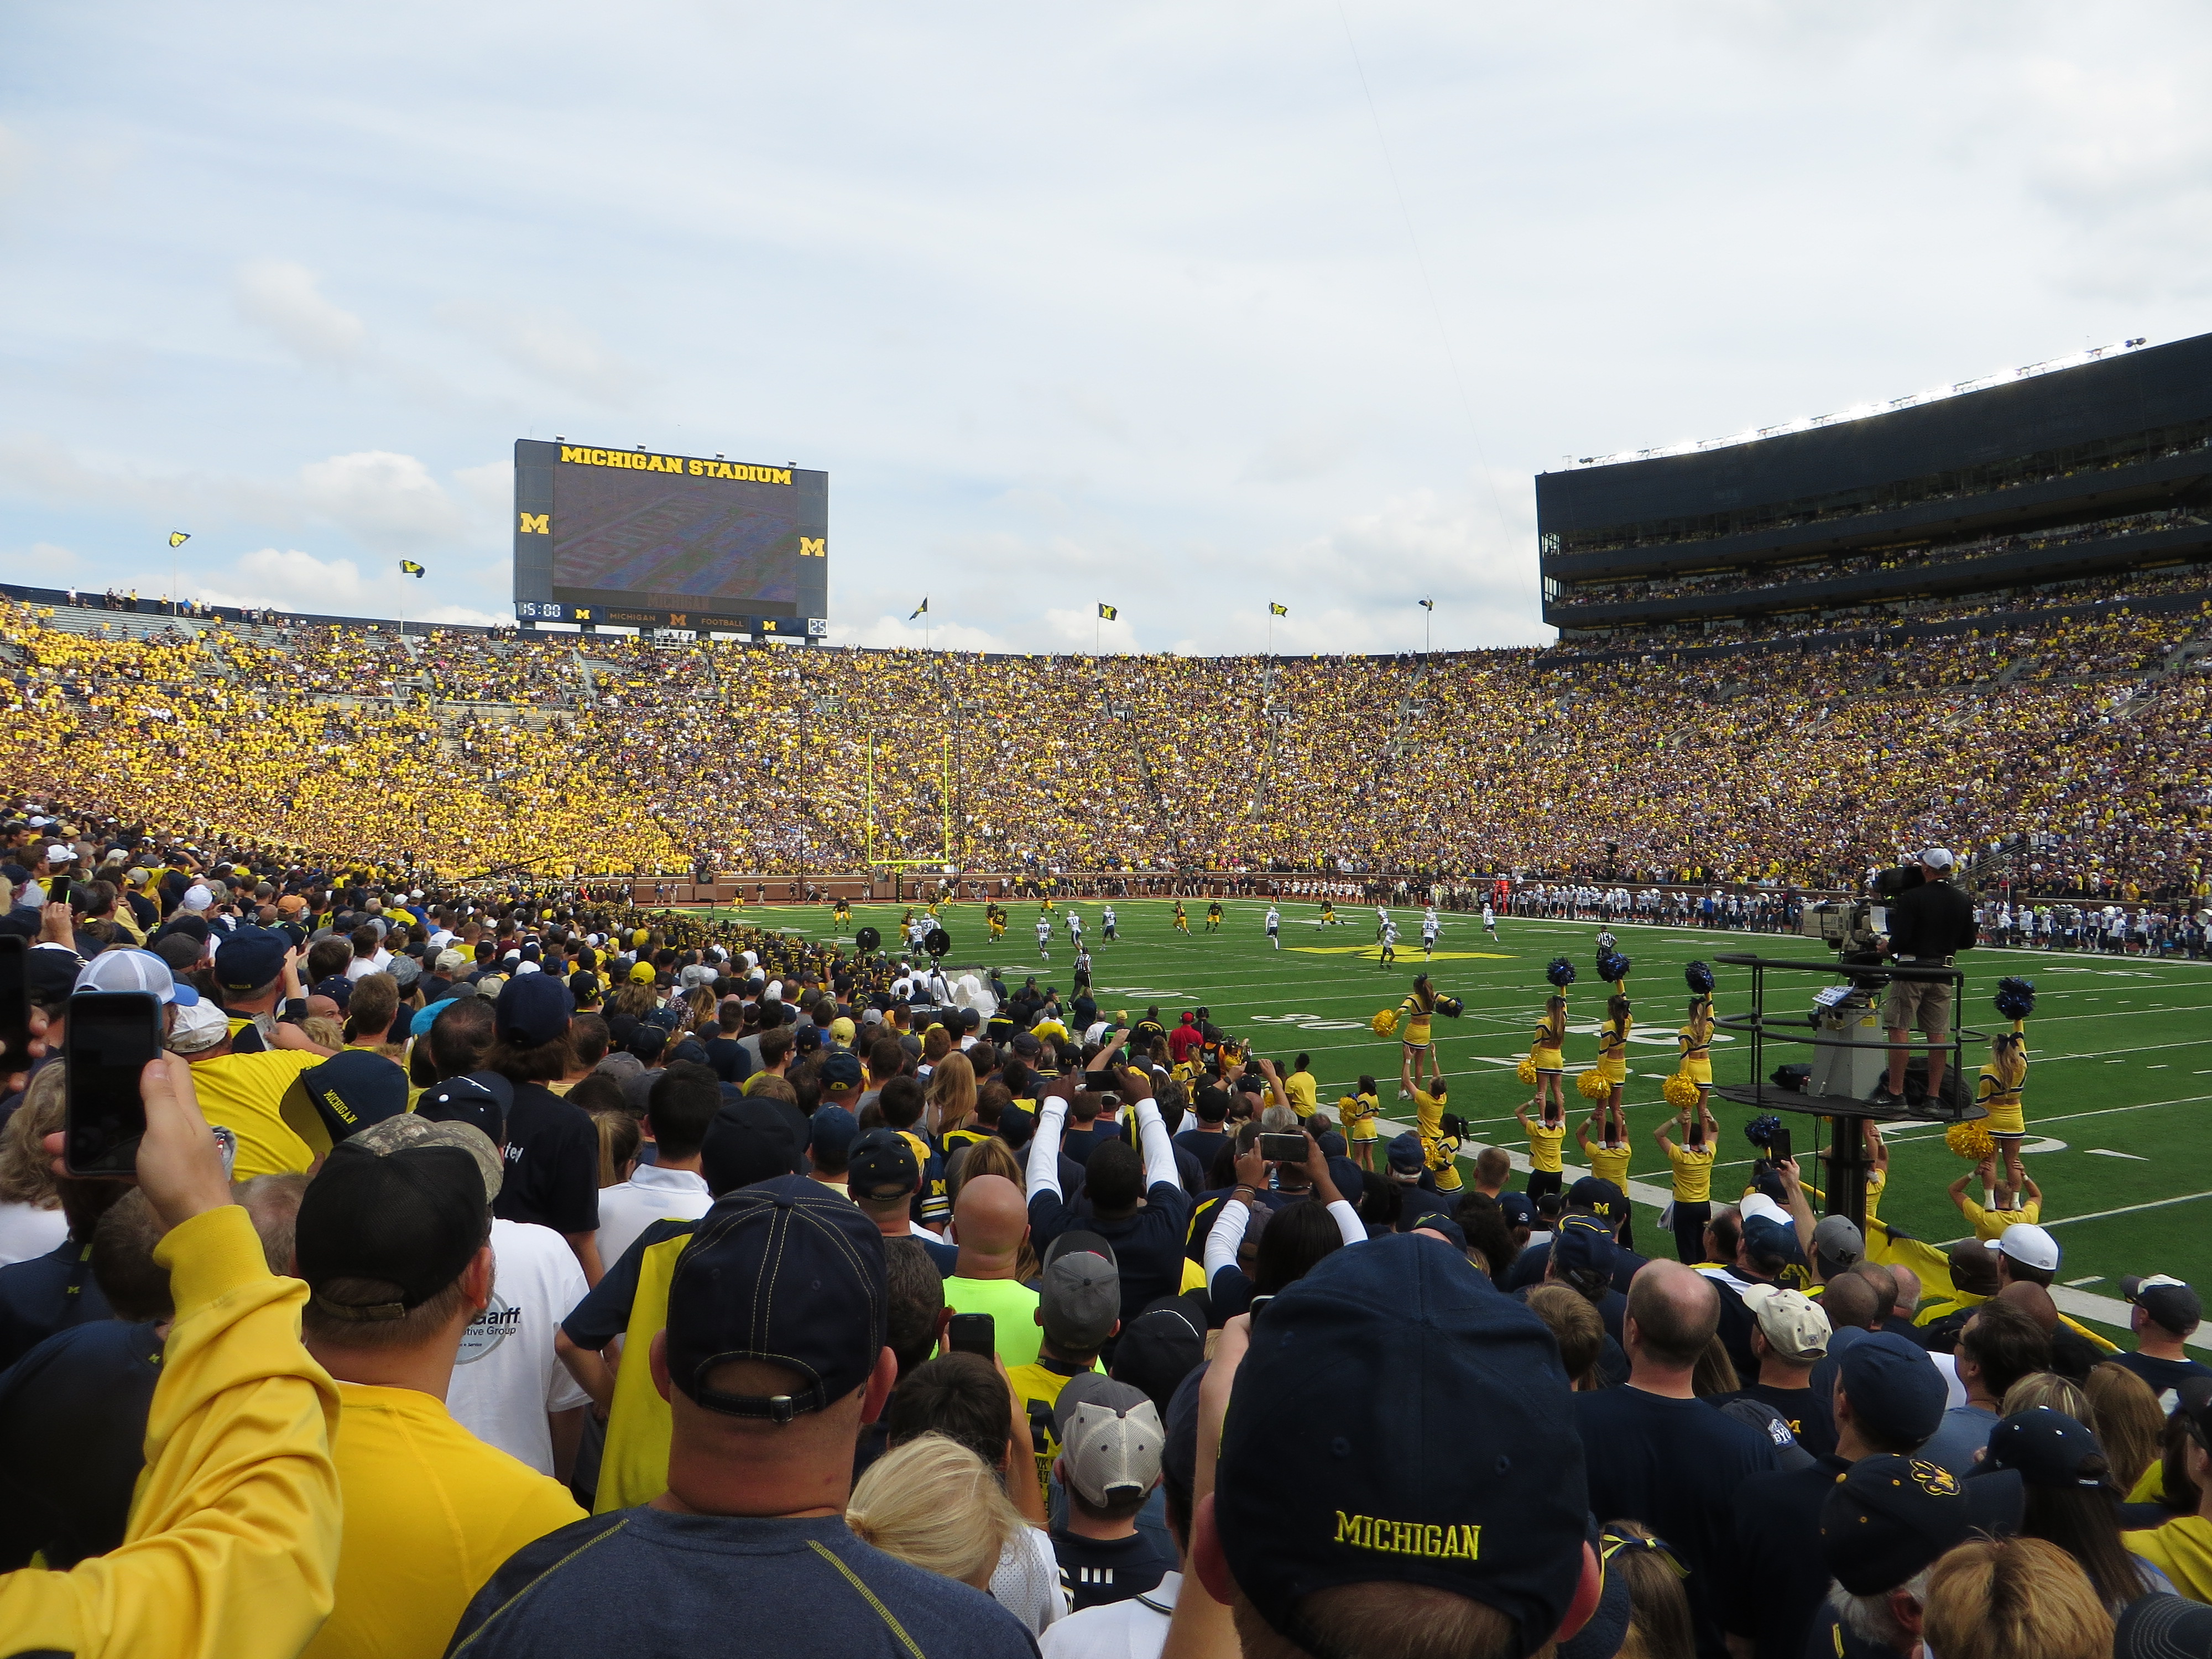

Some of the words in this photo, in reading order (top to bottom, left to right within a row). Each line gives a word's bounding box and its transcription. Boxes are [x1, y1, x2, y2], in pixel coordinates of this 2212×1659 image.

[561, 445, 683, 474] MICHIGAN
[688, 460, 792, 486] STADIUM
[520, 512, 549, 535] M
[800, 536, 825, 557] M
[575, 608, 591, 619] M
[609, 613, 656, 621] MICHIGAN
[670, 613, 687, 626] M
[701, 618, 744, 627] FOOTBALL
[763, 620, 776, 631] M
[811, 620, 826, 633] 25
[1203, 1052, 1215, 1063] M
[323, 1089, 358, 1124] MICHIGAN
[931, 1178, 947, 1196] M
[1593, 1202, 1610, 1215] M
[487, 1326, 517, 1336] Group
[1772, 1428, 1792, 1443] BYU
[1334, 1510, 1482, 1561] MICHIGAN
